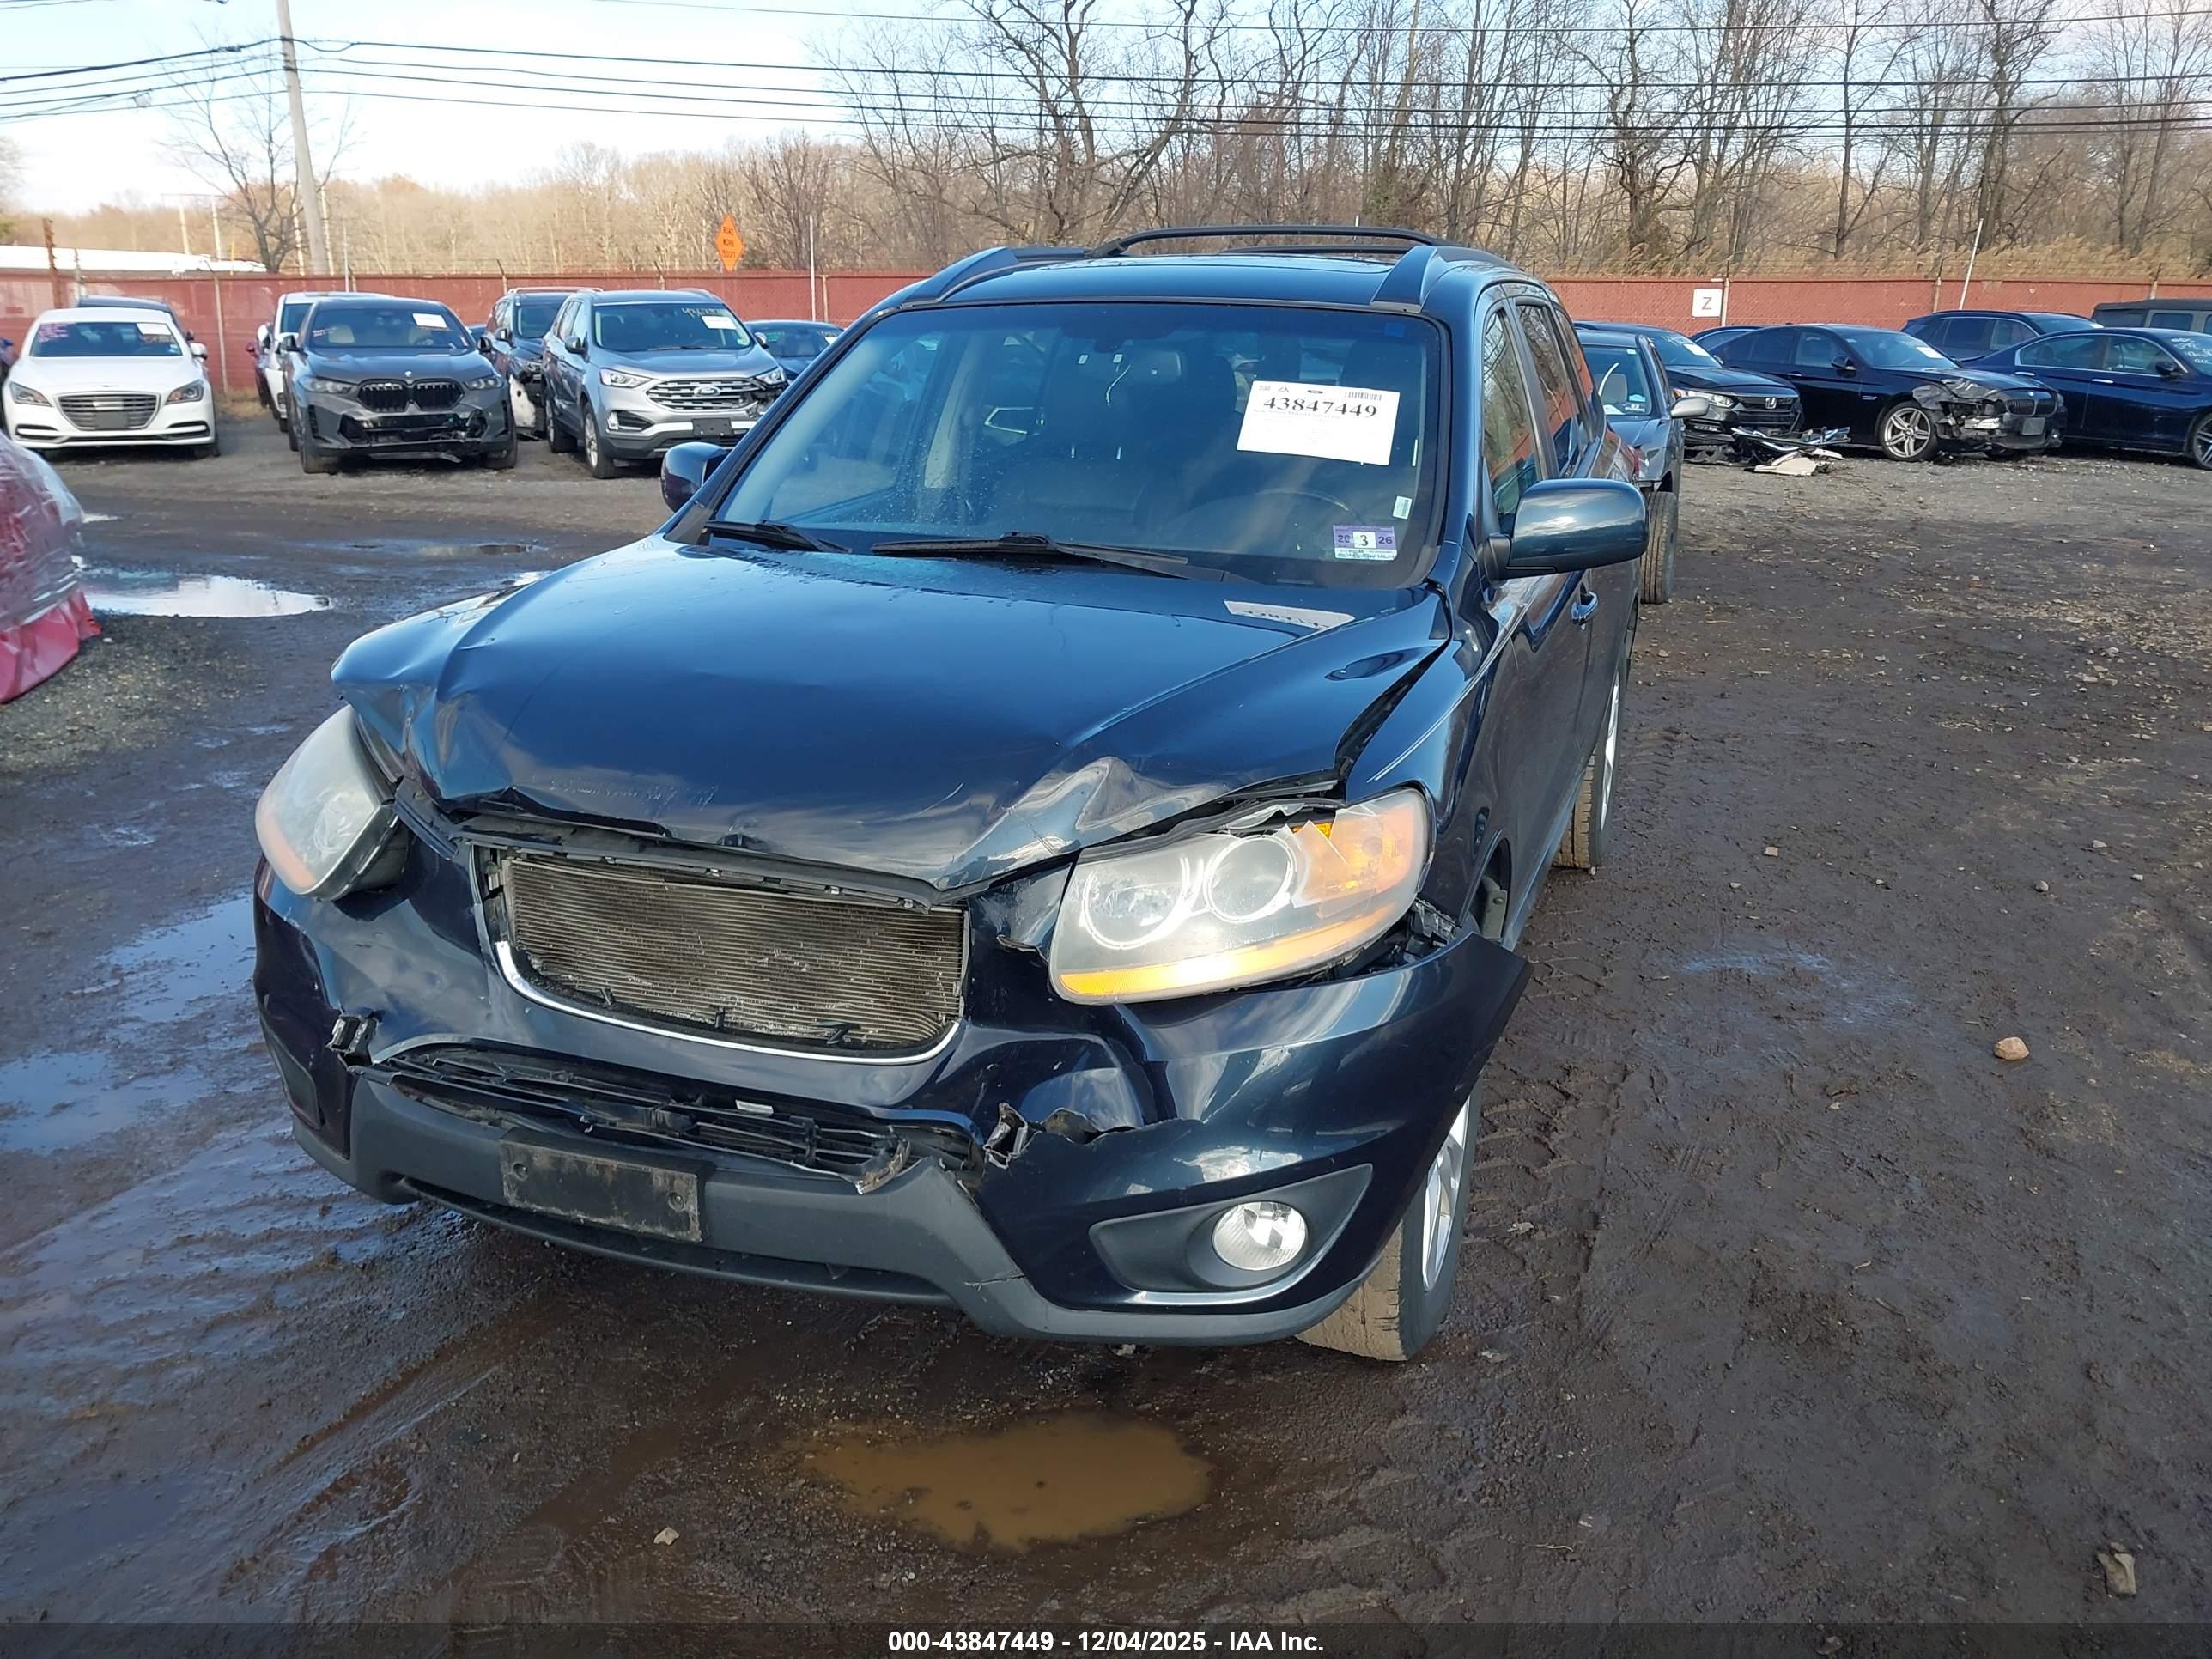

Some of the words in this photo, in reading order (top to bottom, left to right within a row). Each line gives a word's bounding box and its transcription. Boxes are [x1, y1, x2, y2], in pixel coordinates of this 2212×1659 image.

[1702, 296, 1712, 310] Z
[1263, 397, 1378, 418] 43847449
[1360, 534, 1369, 547] 3
[1377, 536, 1393, 544] 26
